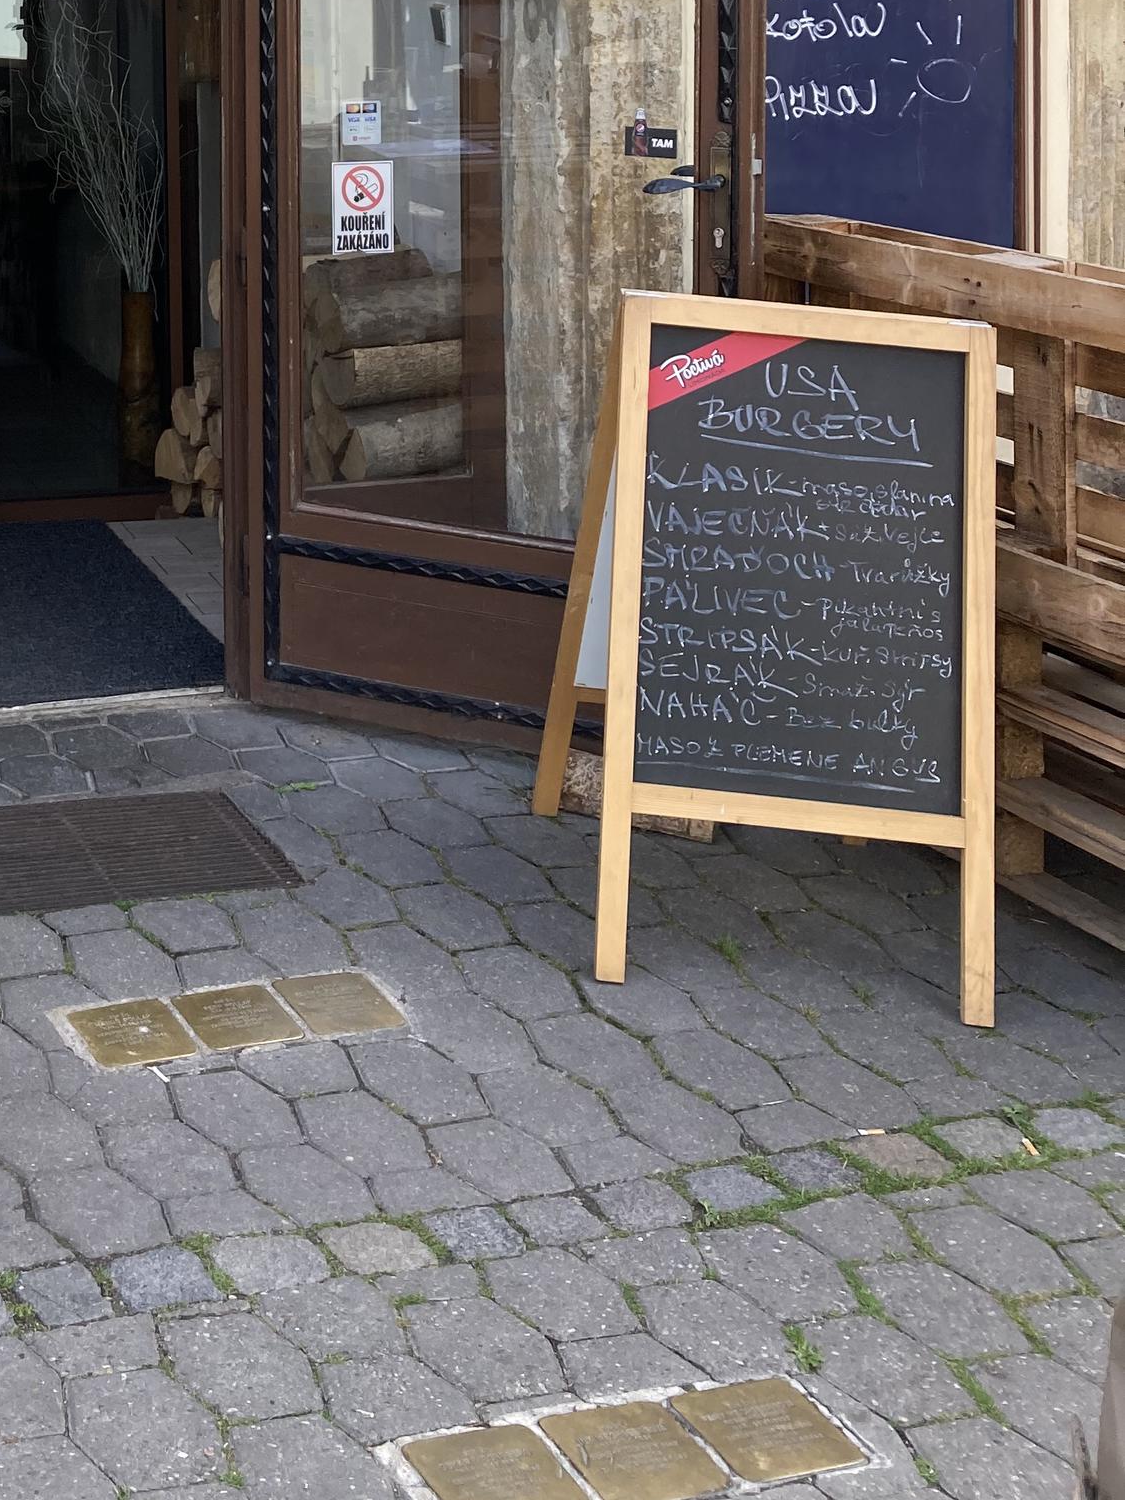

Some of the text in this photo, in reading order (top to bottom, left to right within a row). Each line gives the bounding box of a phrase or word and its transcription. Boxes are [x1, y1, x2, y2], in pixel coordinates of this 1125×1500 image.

[651, 138, 673, 148] TAM
[341, 211, 385, 232] KOUŘENÍ
[337, 231, 389, 250] ZAKÁZÁNO
[660, 349, 724, 388] Poctivá
[764, 361, 859, 412] USA
[698, 399, 921, 452] BURGERY
[646, 450, 805, 496] KLASIK
[636, 732, 701, 756] MASO
